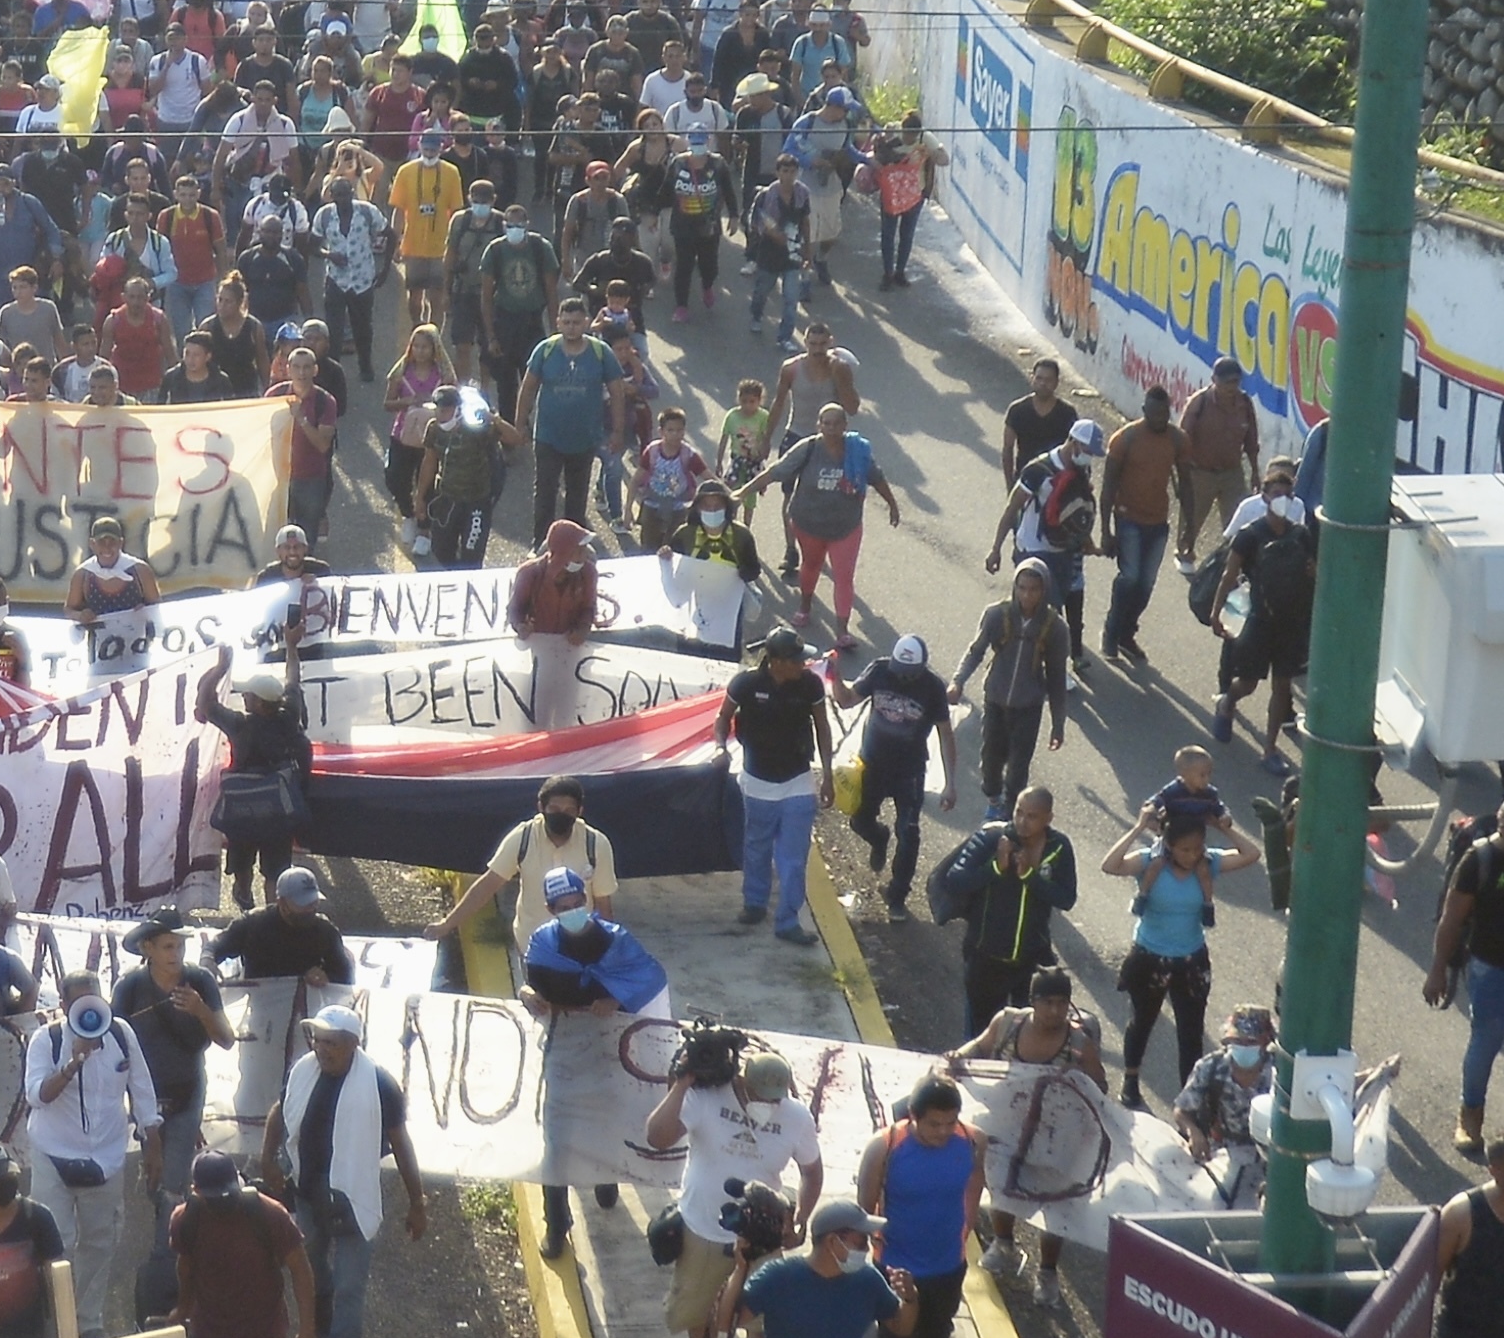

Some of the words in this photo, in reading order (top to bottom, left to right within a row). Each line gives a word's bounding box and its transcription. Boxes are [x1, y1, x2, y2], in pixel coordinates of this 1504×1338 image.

[974, 45, 1010, 134] Sayer
[1054, 106, 1098, 253] 13
[1095, 162, 1290, 402] America
[1302, 225, 1343, 300] Leye
[385, 653, 540, 729] BEEN
